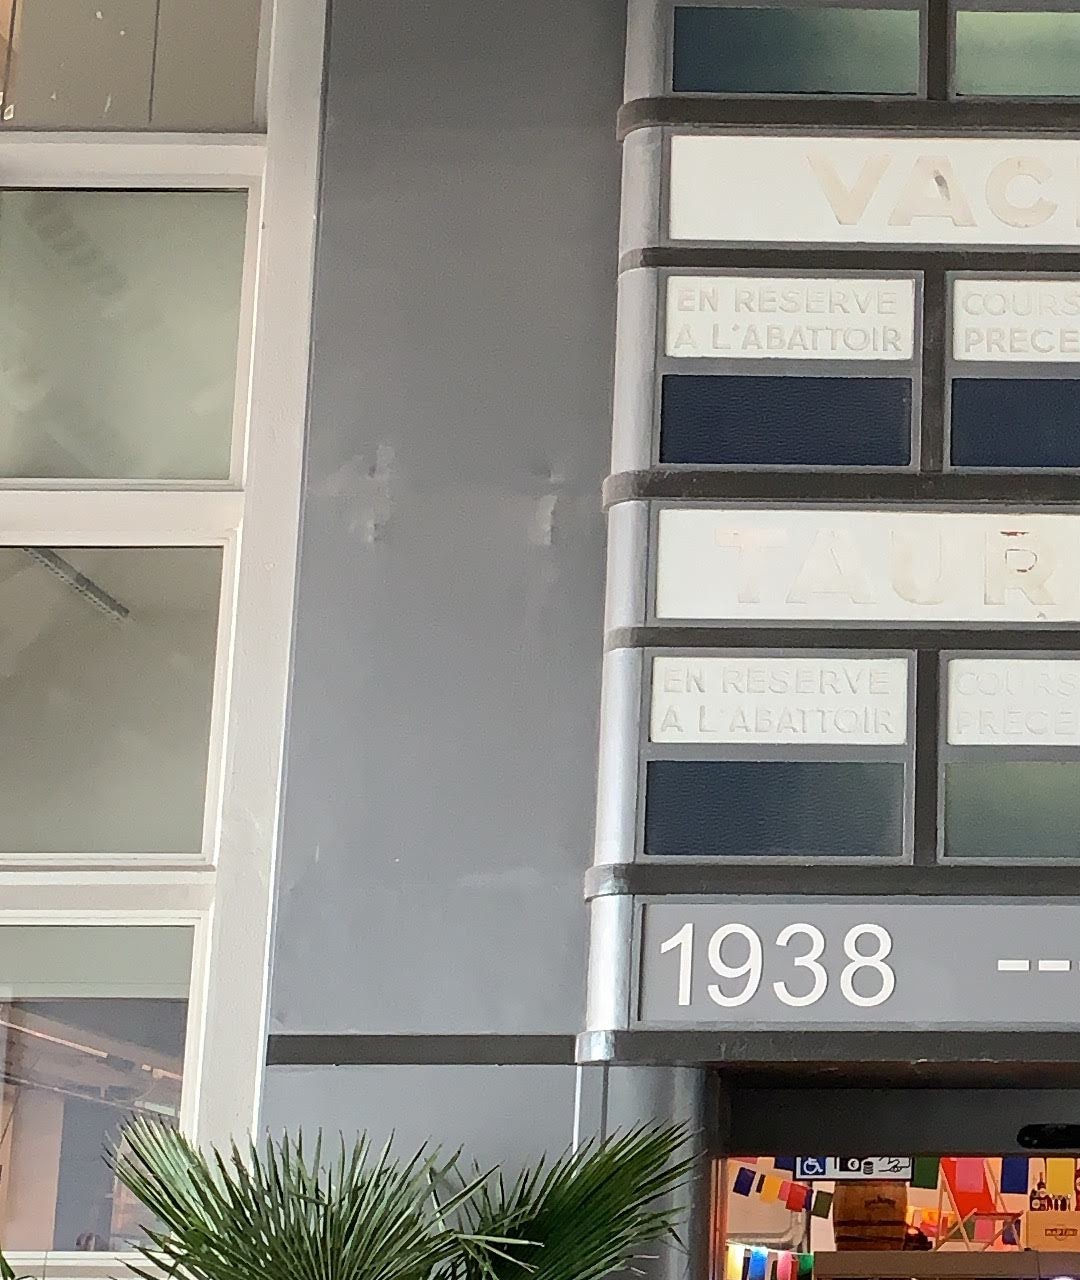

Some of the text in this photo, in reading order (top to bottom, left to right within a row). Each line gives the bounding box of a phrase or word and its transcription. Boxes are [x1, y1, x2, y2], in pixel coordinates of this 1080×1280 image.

[677, 286, 719, 312] EN
[673, 323, 903, 352] A L'ABATTOIR
[663, 666, 706, 693] EN
[660, 704, 894, 734] A L'ABATTOIR
[660, 923, 896, 1007] 1938
